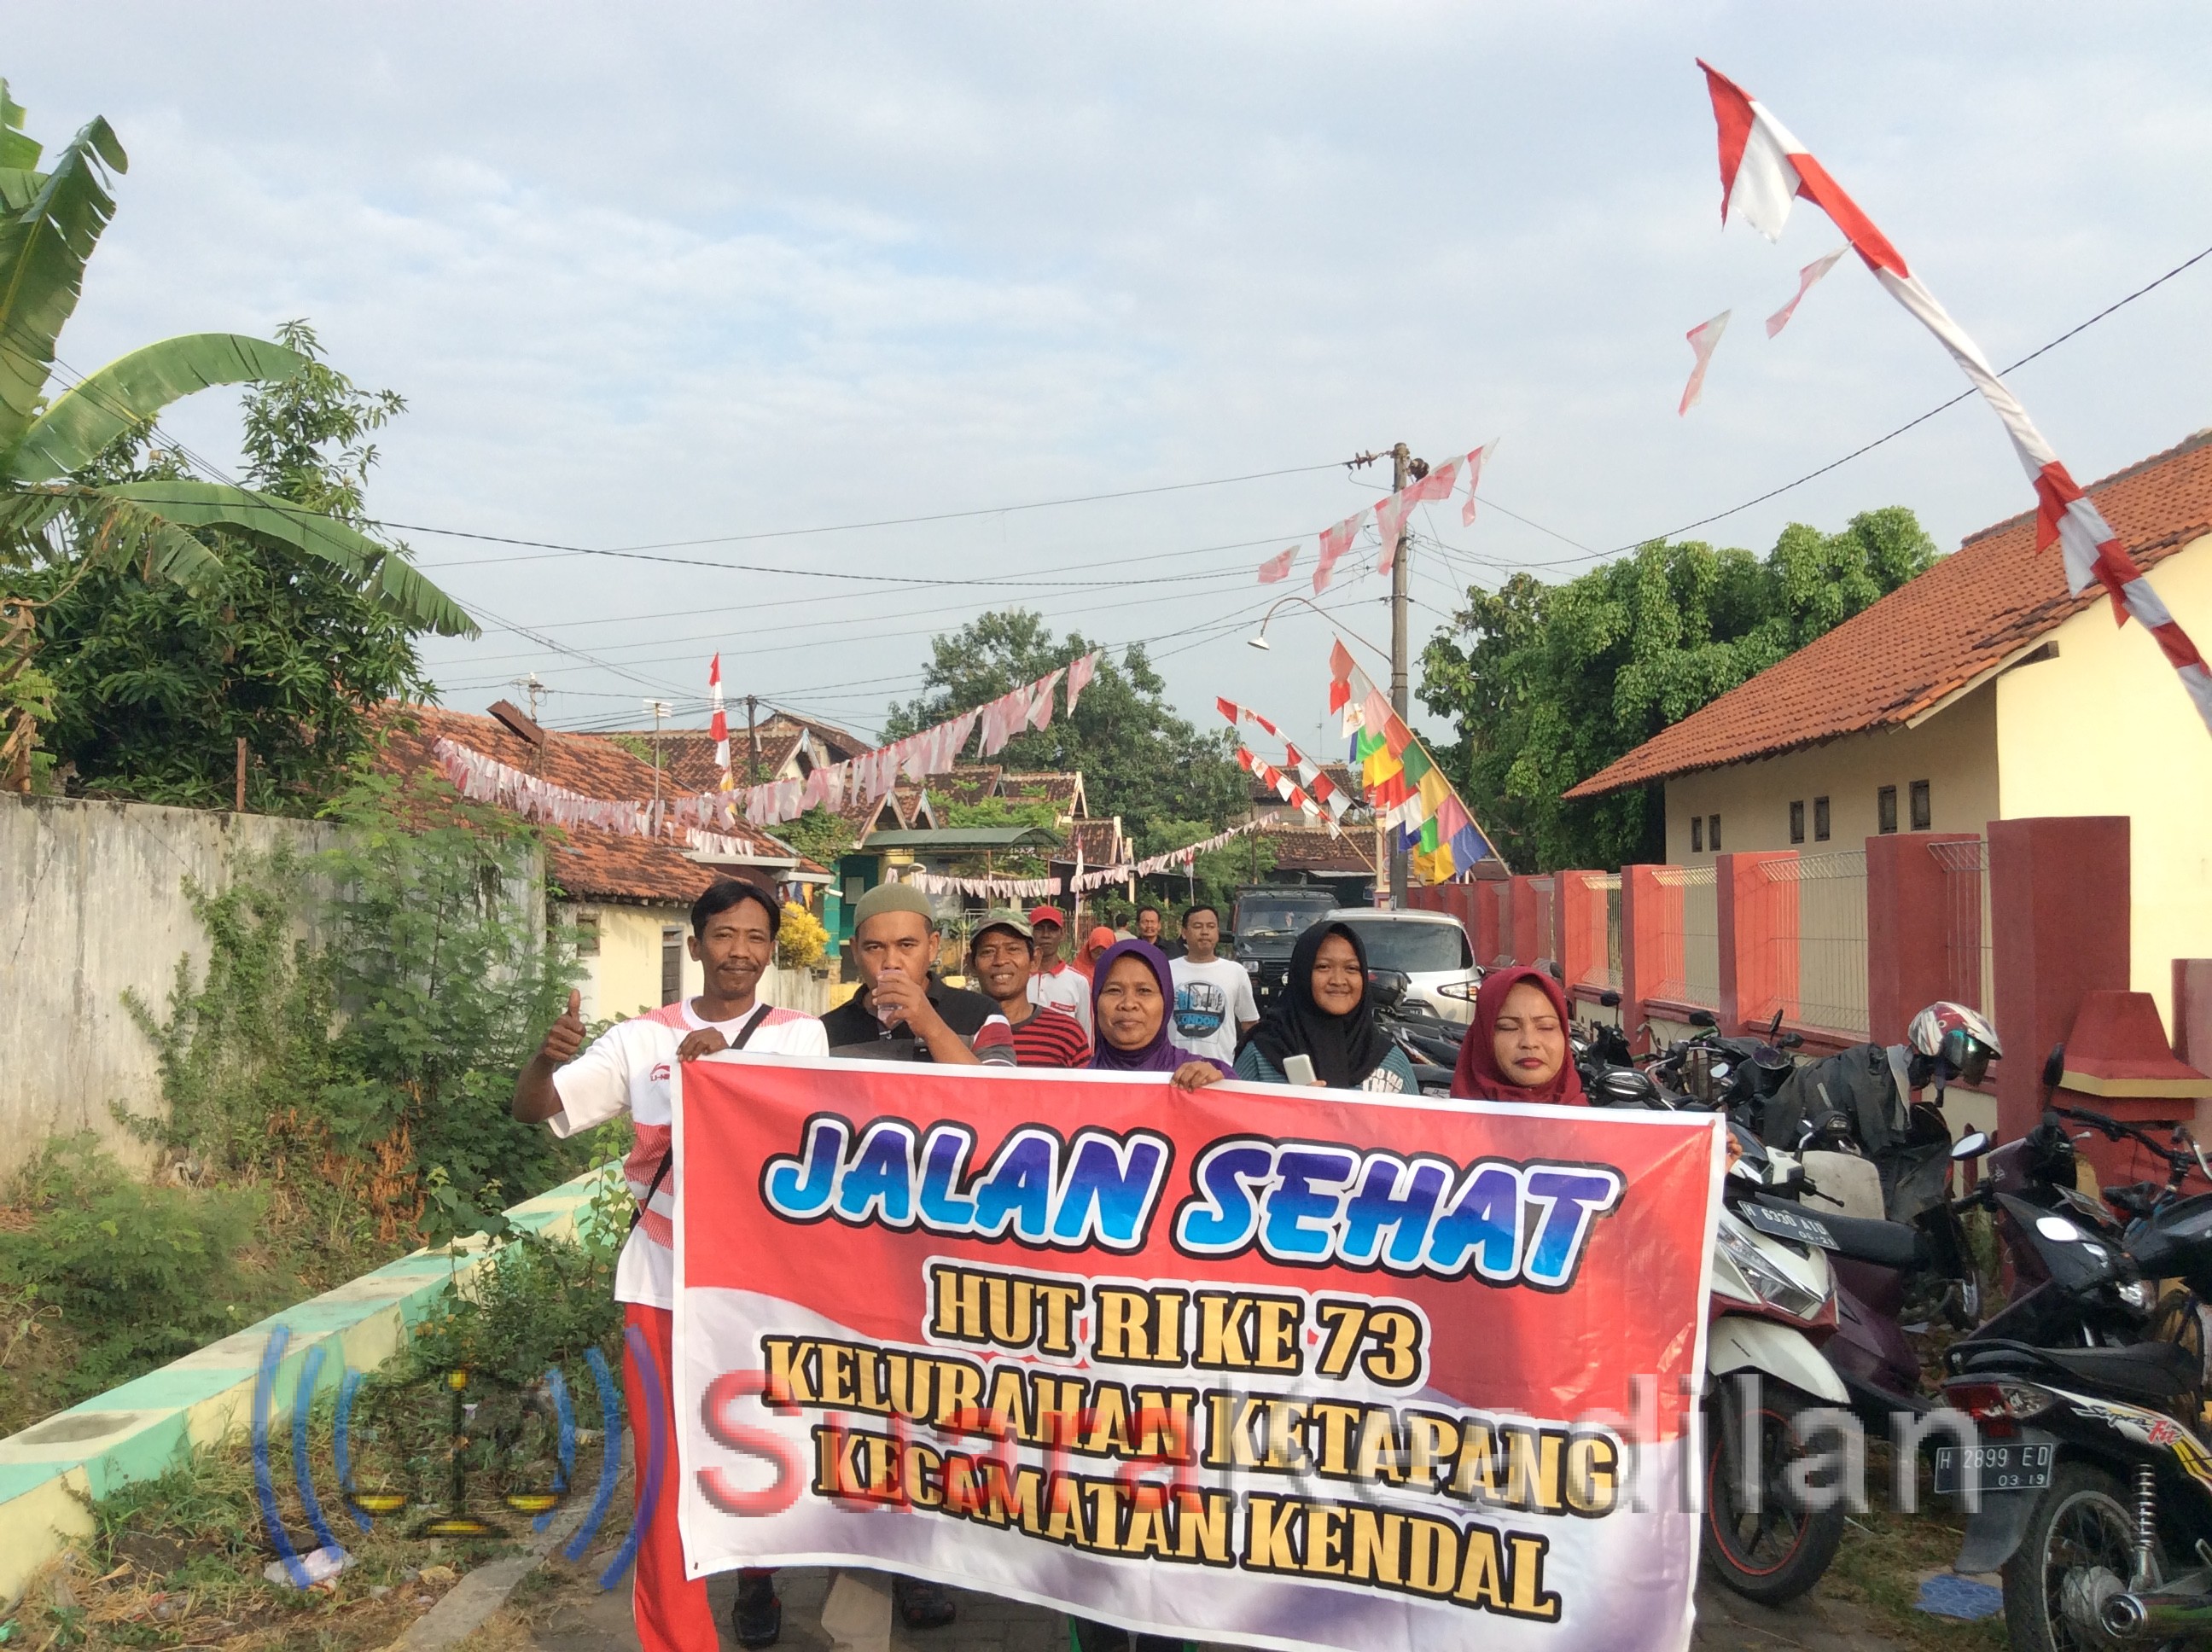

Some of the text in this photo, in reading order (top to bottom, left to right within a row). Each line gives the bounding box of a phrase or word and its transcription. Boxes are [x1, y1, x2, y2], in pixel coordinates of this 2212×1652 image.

[760, 1113, 1625, 1292] JALAN SEHAT
[1743, 1203, 1756, 1217] H
[1761, 1207, 1797, 1227] 6330
[931, 1265, 1423, 1387] HUT RI KE 73
[761, 1335, 1622, 1516] KELURAHAN KETAPANG
[1940, 1446, 2048, 1469] H 2899 ED
[811, 1426, 1561, 1623] KECAMATAN KENDAL
